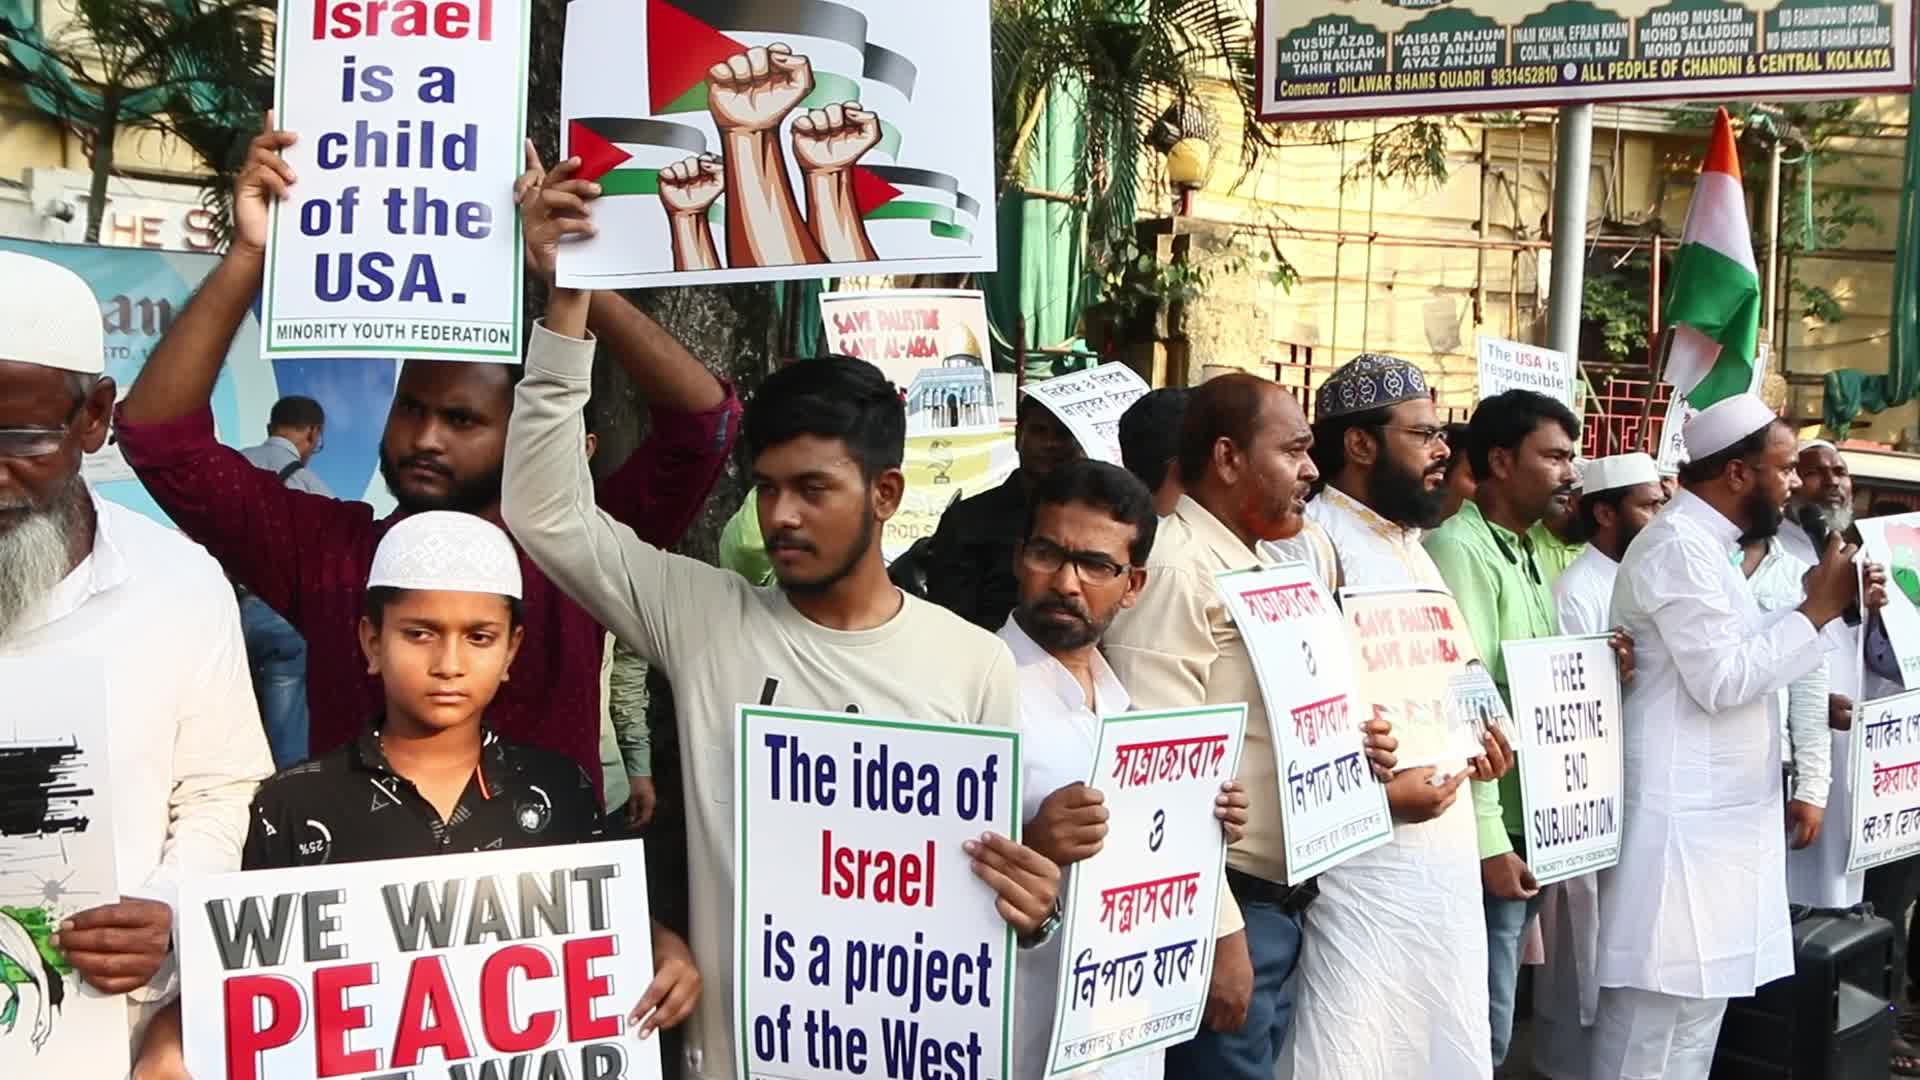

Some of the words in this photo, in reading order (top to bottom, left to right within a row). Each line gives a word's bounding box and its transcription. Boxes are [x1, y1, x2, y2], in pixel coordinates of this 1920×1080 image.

[312, 0, 493, 41] Israel
[1318, 23, 1349, 36] HAJI
[1601, 22, 1628, 39] KHAN
[1640, 27, 1678, 42] MOHD
[1680, 22, 1754, 40] SALAUDDIN
[1652, 10, 1689, 26] MOHD
[1692, 7, 1743, 24] MUSLIM
[1281, 51, 1319, 64] MOHD
[1322, 46, 1385, 60] NAULAKH
[1293, 37, 1336, 50] YUSUF
[1340, 34, 1374, 47] AZAD
[1394, 32, 1449, 46] KAISAR
[1453, 29, 1505, 42] ANJUM
[1401, 44, 1441, 57] ASAD
[1445, 41, 1497, 54] ANJUM
[1644, 42, 1682, 57] MOHD
[1684, 38, 1749, 56] ALLUDDIN
[342, 55, 394, 103] is
[418, 66, 455, 103] a
[1280, 80, 1330, 97] Convenor
[1339, 75, 1392, 94] DILAWAR
[1395, 71, 1436, 90] SHAMS
[1439, 69, 1485, 88] QUADRI
[1491, 65, 1558, 86] 9831452810
[1293, 63, 1332, 75] TAHIR
[1335, 60, 1373, 73] KHAN
[1402, 56, 1440, 69] AYAZ
[1443, 53, 1496, 67] ANJUM
[1581, 63, 1605, 82] ALL
[1608, 59, 1658, 80] PEOPLE
[1661, 58, 1679, 78] OF
[1682, 55, 1743, 77] CHANDNI
[1746, 55, 1756, 74] &
[1759, 51, 1823, 74] CENTRAL
[1826, 48, 1891, 70] KOLKATA
[316, 120, 478, 172] child
[112, 212, 163, 247] HE
[300, 186, 360, 236] of
[384, 186, 494, 239] the
[314, 252, 467, 304] USA.
[276, 323, 348, 340] MINORITY
[352, 323, 406, 340] YOUTH
[411, 325, 510, 344] FEDERATION
[1484, 362, 1564, 390] responsible
[1488, 344, 1511, 361] The
[1516, 351, 1542, 369] USA
[1548, 357, 1560, 372] is
[1551, 652, 1586, 693] FREE
[764, 734, 837, 806] The
[852, 741, 940, 816] idea
[956, 754, 998, 822] of
[1112, 735, 1229, 789] সাম্রাজ্যবাদ
[1564, 752, 1588, 792] END
[1150, 809, 1165, 852] ও
[1534, 796, 1617, 849] SUBJUGATION.
[822, 830, 935, 907] Israel
[205, 889, 347, 970] WE
[381, 864, 621, 952] WANT
[1100, 872, 1200, 933] সন্ত্রাসবাদ
[763, 913, 795, 982] is
[808, 934, 831, 987] a
[846, 931, 992, 1015] project
[1072, 948, 1148, 1010] নিপাত
[223, 935, 621, 1080] PEACE
[754, 1004, 791, 1063] of
[804, 1009, 868, 1076] the
